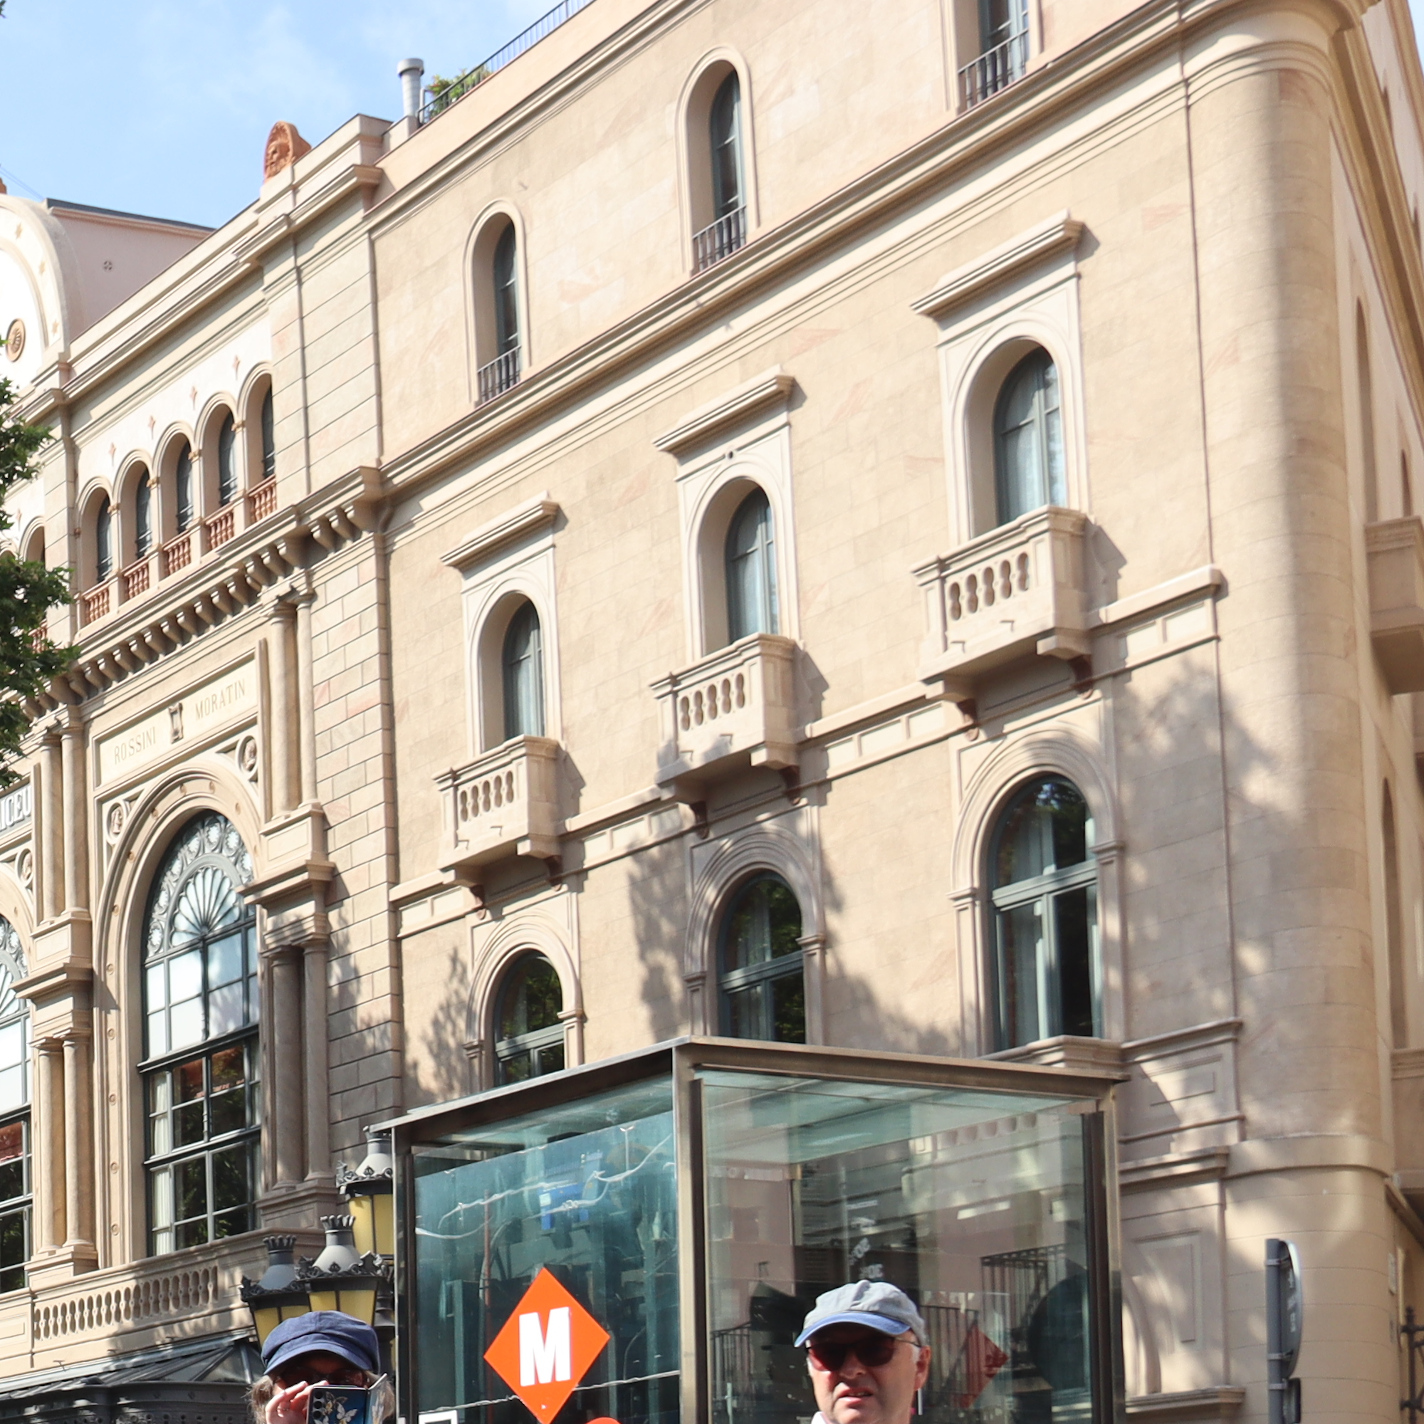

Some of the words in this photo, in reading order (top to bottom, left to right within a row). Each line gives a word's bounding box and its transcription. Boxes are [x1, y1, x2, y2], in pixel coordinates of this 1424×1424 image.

[114, 726, 157, 765] ROSSINI
[195, 679, 246, 721] MORATIN
[518, 1306, 571, 1387] M
